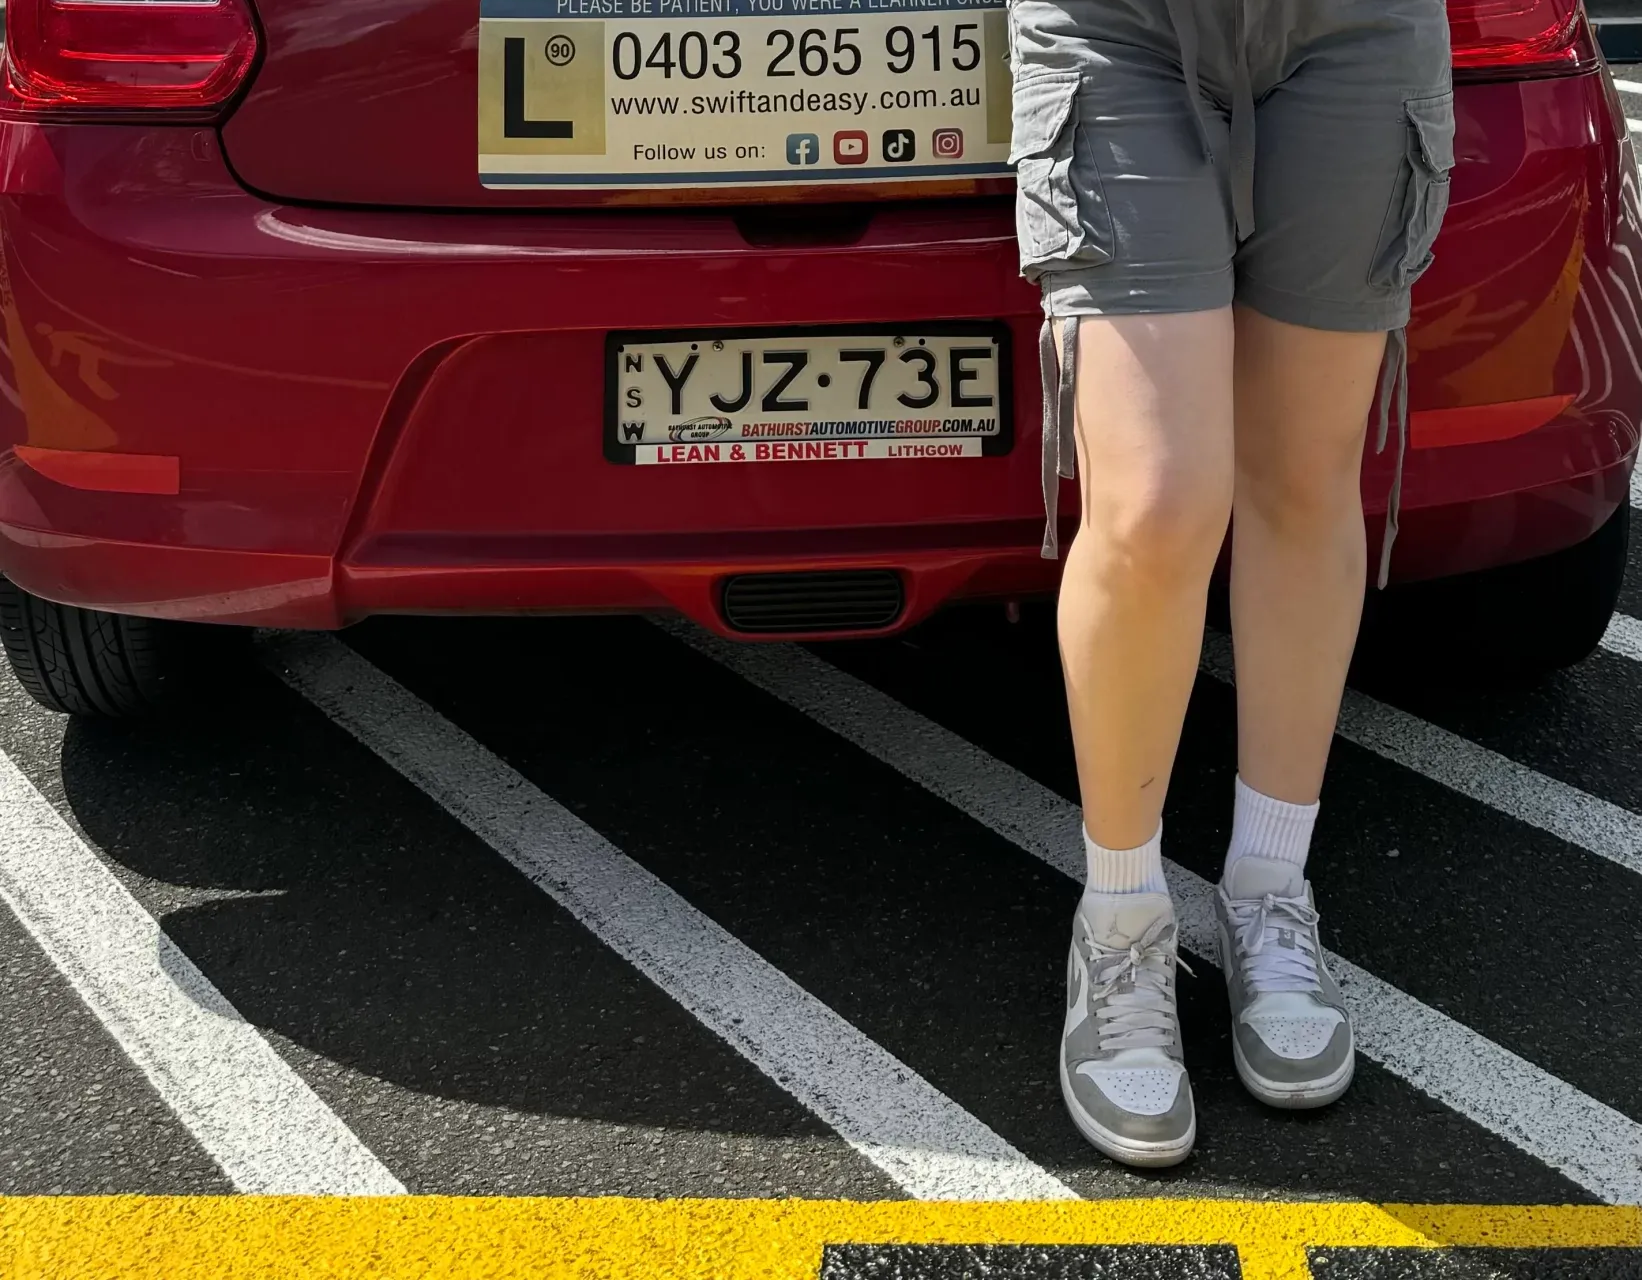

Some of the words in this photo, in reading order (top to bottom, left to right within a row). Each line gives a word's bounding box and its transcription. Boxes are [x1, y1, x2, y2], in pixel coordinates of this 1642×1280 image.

[550, 43, 570, 59] 90
[611, 30, 742, 80] 0403
[766, 27, 862, 77] 265
[884, 23, 981, 75] 915
[504, 37, 573, 138] L
[611, 86, 981, 115] www.swiftandeasy.com.au
[633, 143, 696, 161] Follow
[704, 145, 727, 160] us
[735, 143, 766, 160] on:
[741, 418, 996, 438] BATHURSTAUTOMOTIVEGROUP.COM.AU
[657, 444, 726, 463] LEAN
[729, 442, 747, 461] &
[755, 440, 868, 460] BENNETT
[887, 443, 963, 458] LITHGOW
